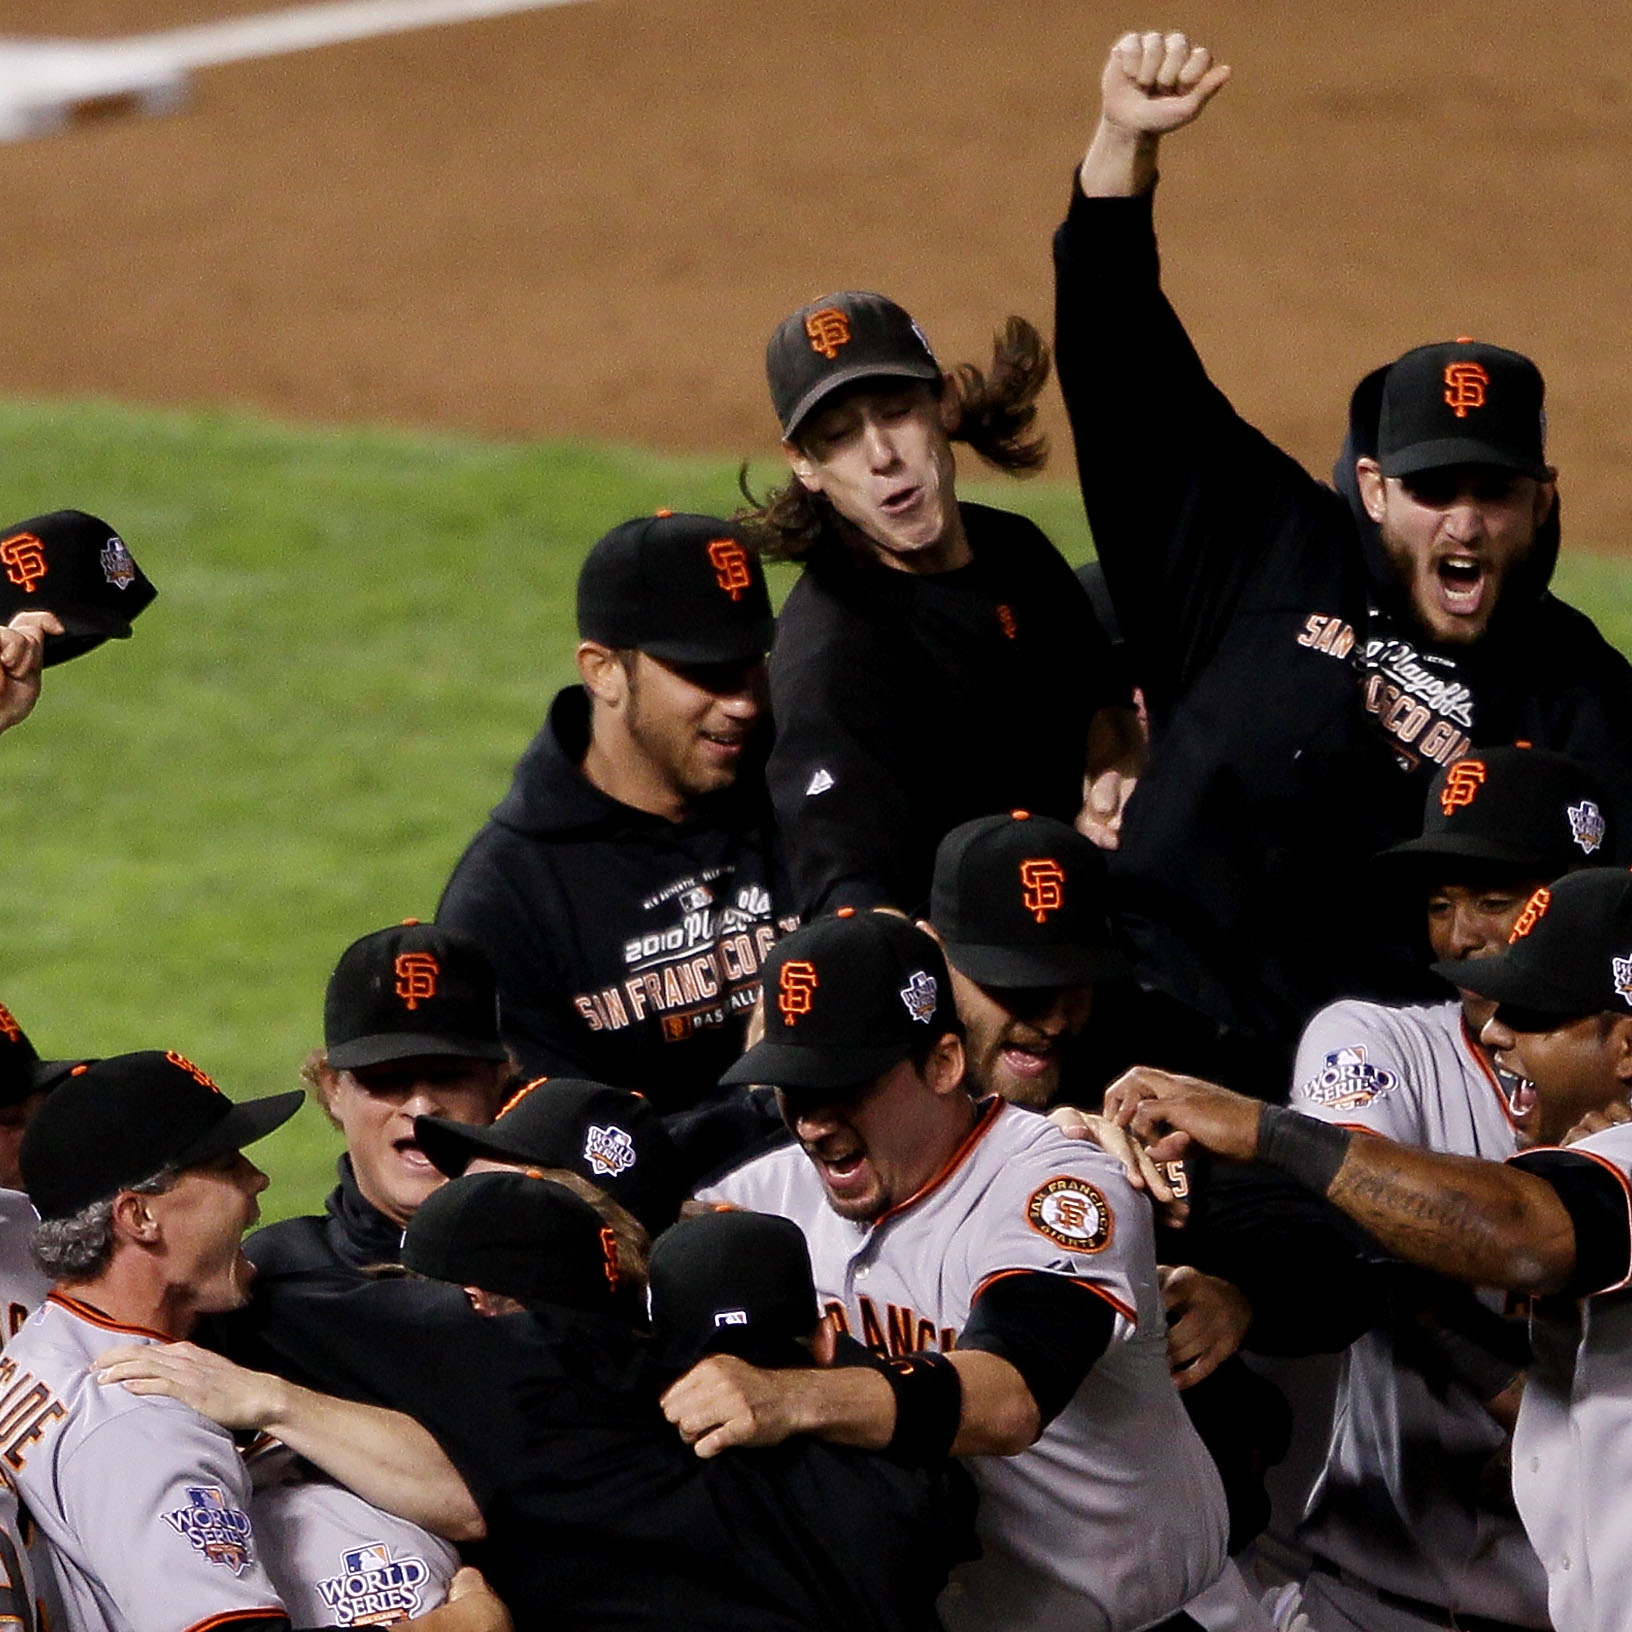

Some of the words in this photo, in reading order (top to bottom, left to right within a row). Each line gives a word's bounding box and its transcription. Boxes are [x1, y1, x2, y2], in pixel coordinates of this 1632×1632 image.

[805, 307, 852, 360] SF
[1443, 361, 1489, 418] SF
[707, 538, 752, 601] SF
[1297, 614, 1356, 659] SAN
[1440, 757, 1487, 817] SF
[1019, 858, 1066, 924] SF
[624, 929, 683, 963] 2010
[394, 952, 439, 1010] SF
[777, 959, 819, 1027] SF
[1300, 1065, 1394, 1098] WORLD
[163, 1507, 249, 1536] WORLD
[319, 1559, 426, 1604] WORLD
[337, 1584, 418, 1624] SERIES
